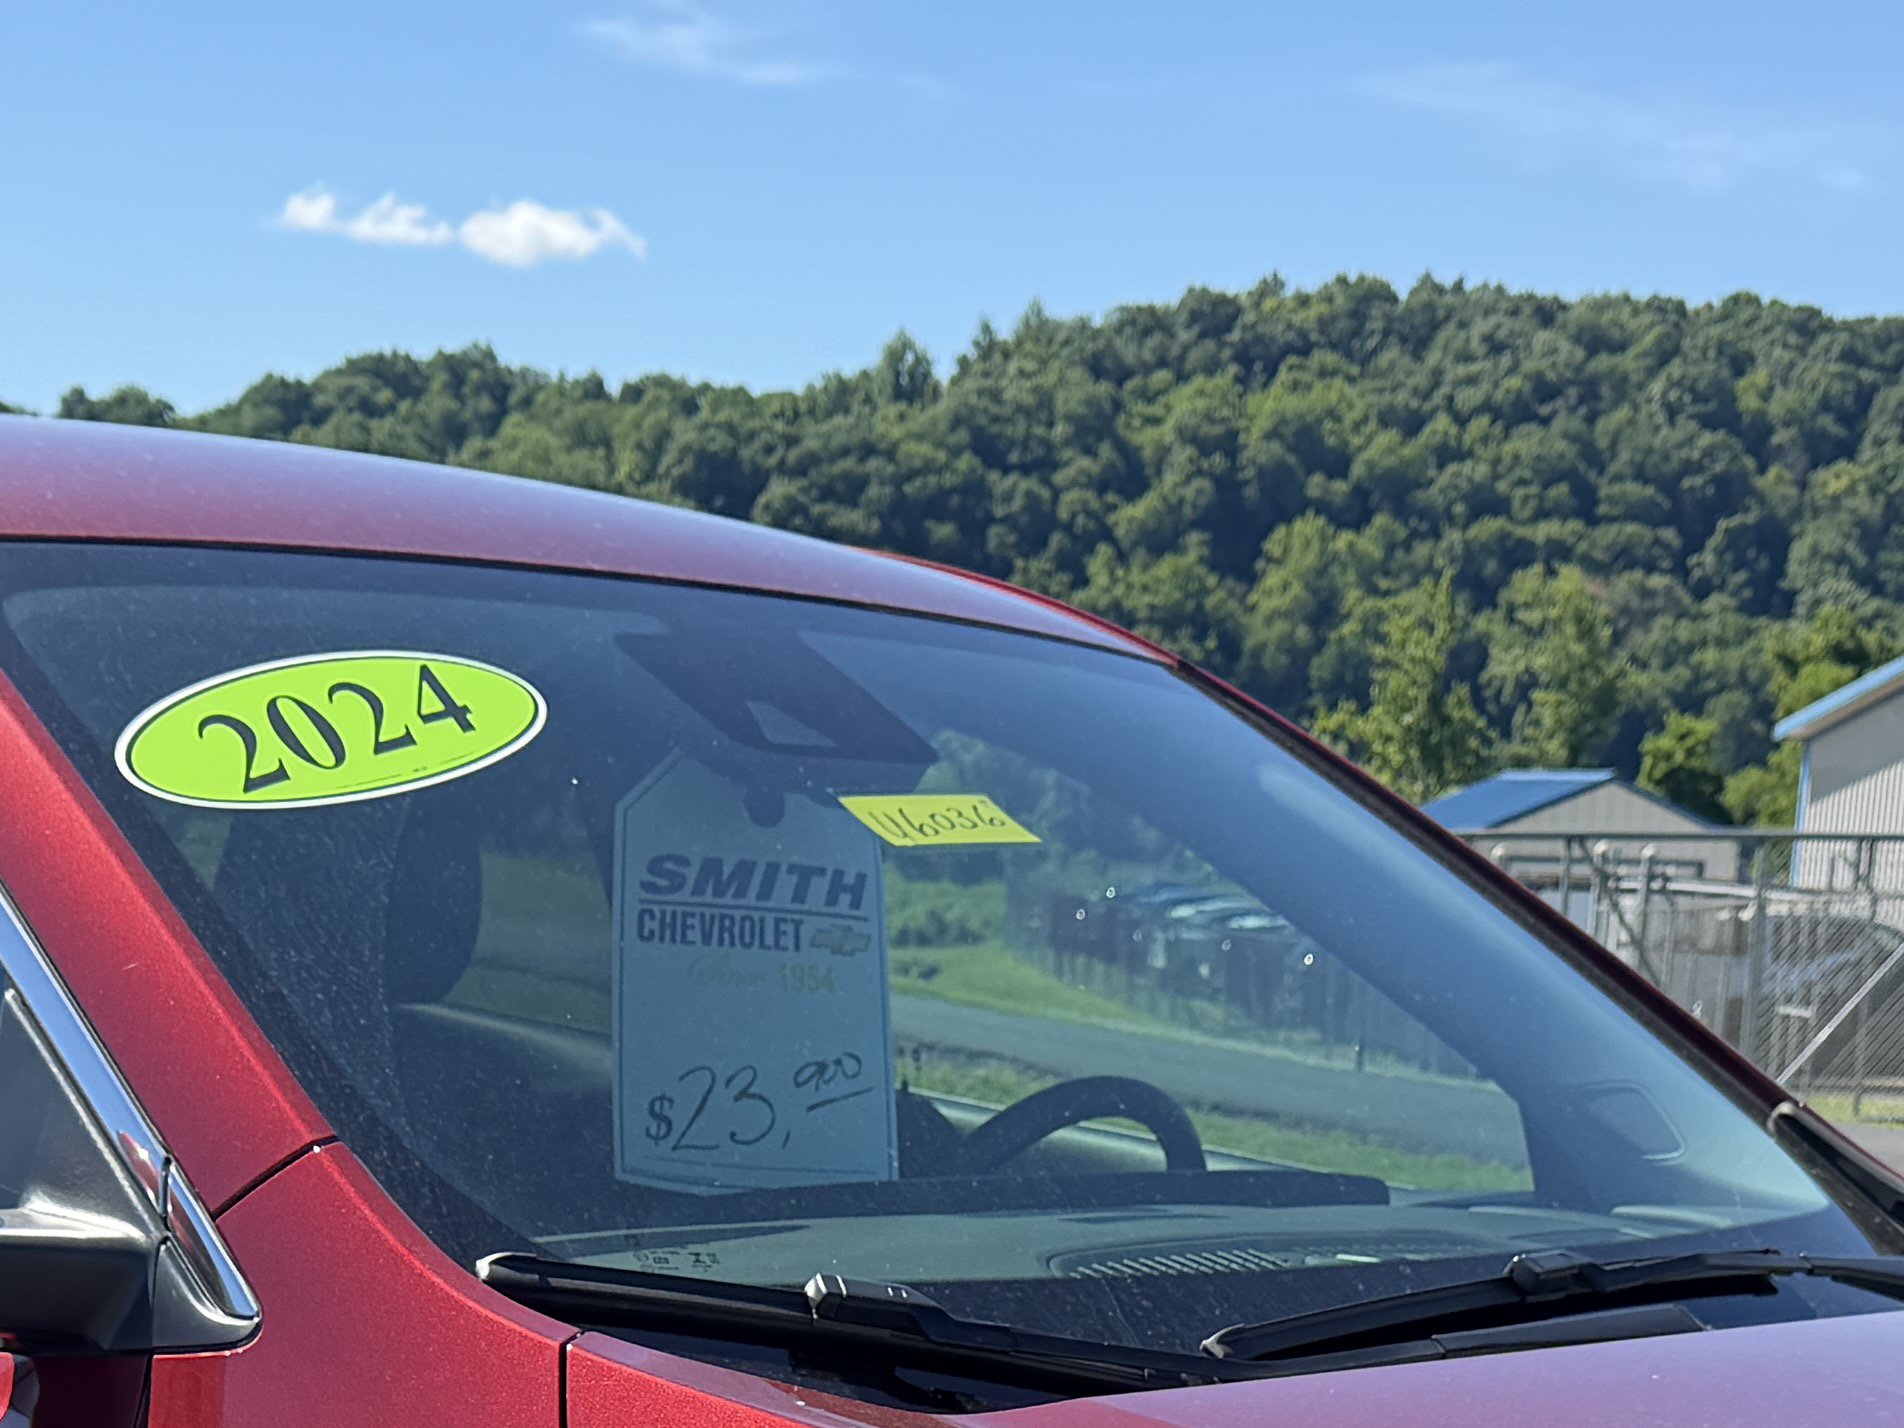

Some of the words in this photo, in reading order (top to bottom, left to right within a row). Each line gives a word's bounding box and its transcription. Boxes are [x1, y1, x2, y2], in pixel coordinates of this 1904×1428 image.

[197, 663, 476, 794] 2024
[638, 853, 869, 911] SMITH
[636, 907, 805, 953] CHEVROLET
